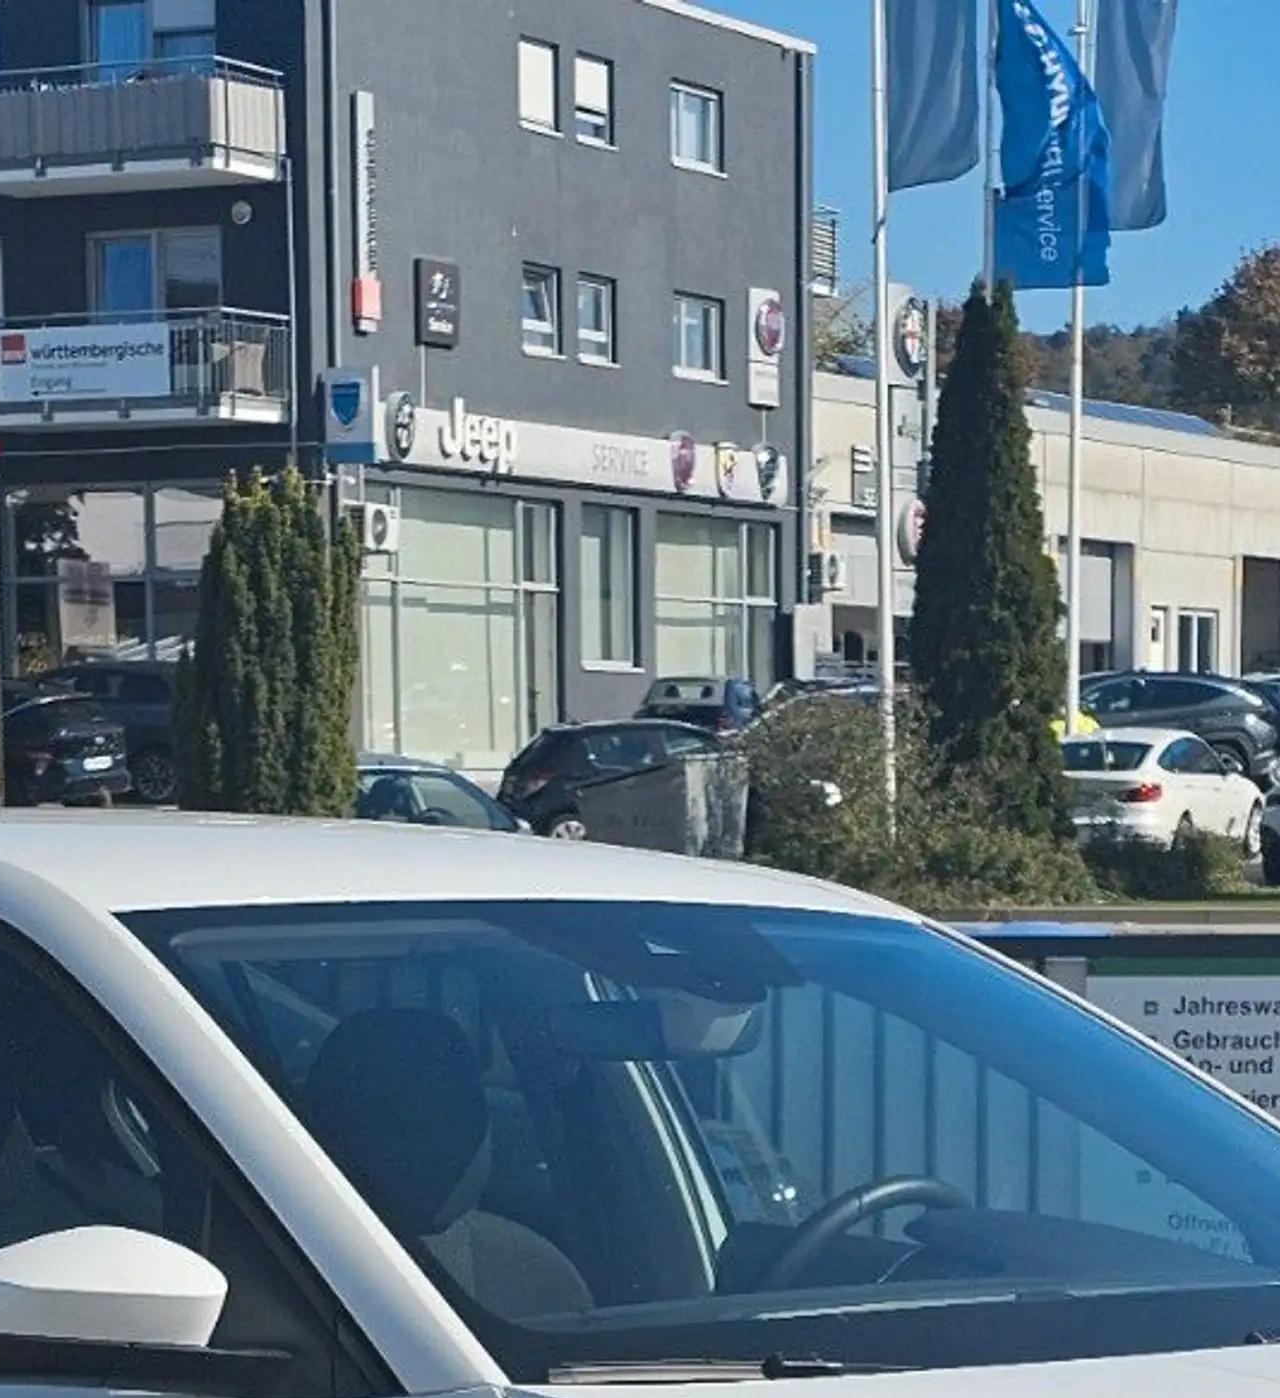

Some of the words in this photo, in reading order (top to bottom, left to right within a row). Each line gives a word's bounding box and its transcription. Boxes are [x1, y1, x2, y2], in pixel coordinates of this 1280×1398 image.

[1035, 183, 1063, 262] ervice
[31, 341, 165, 361] württembergische
[439, 397, 519, 475] Jeep
[591, 444, 649, 477] SERVICE
[1230, 1056, 1273, 1074] und
